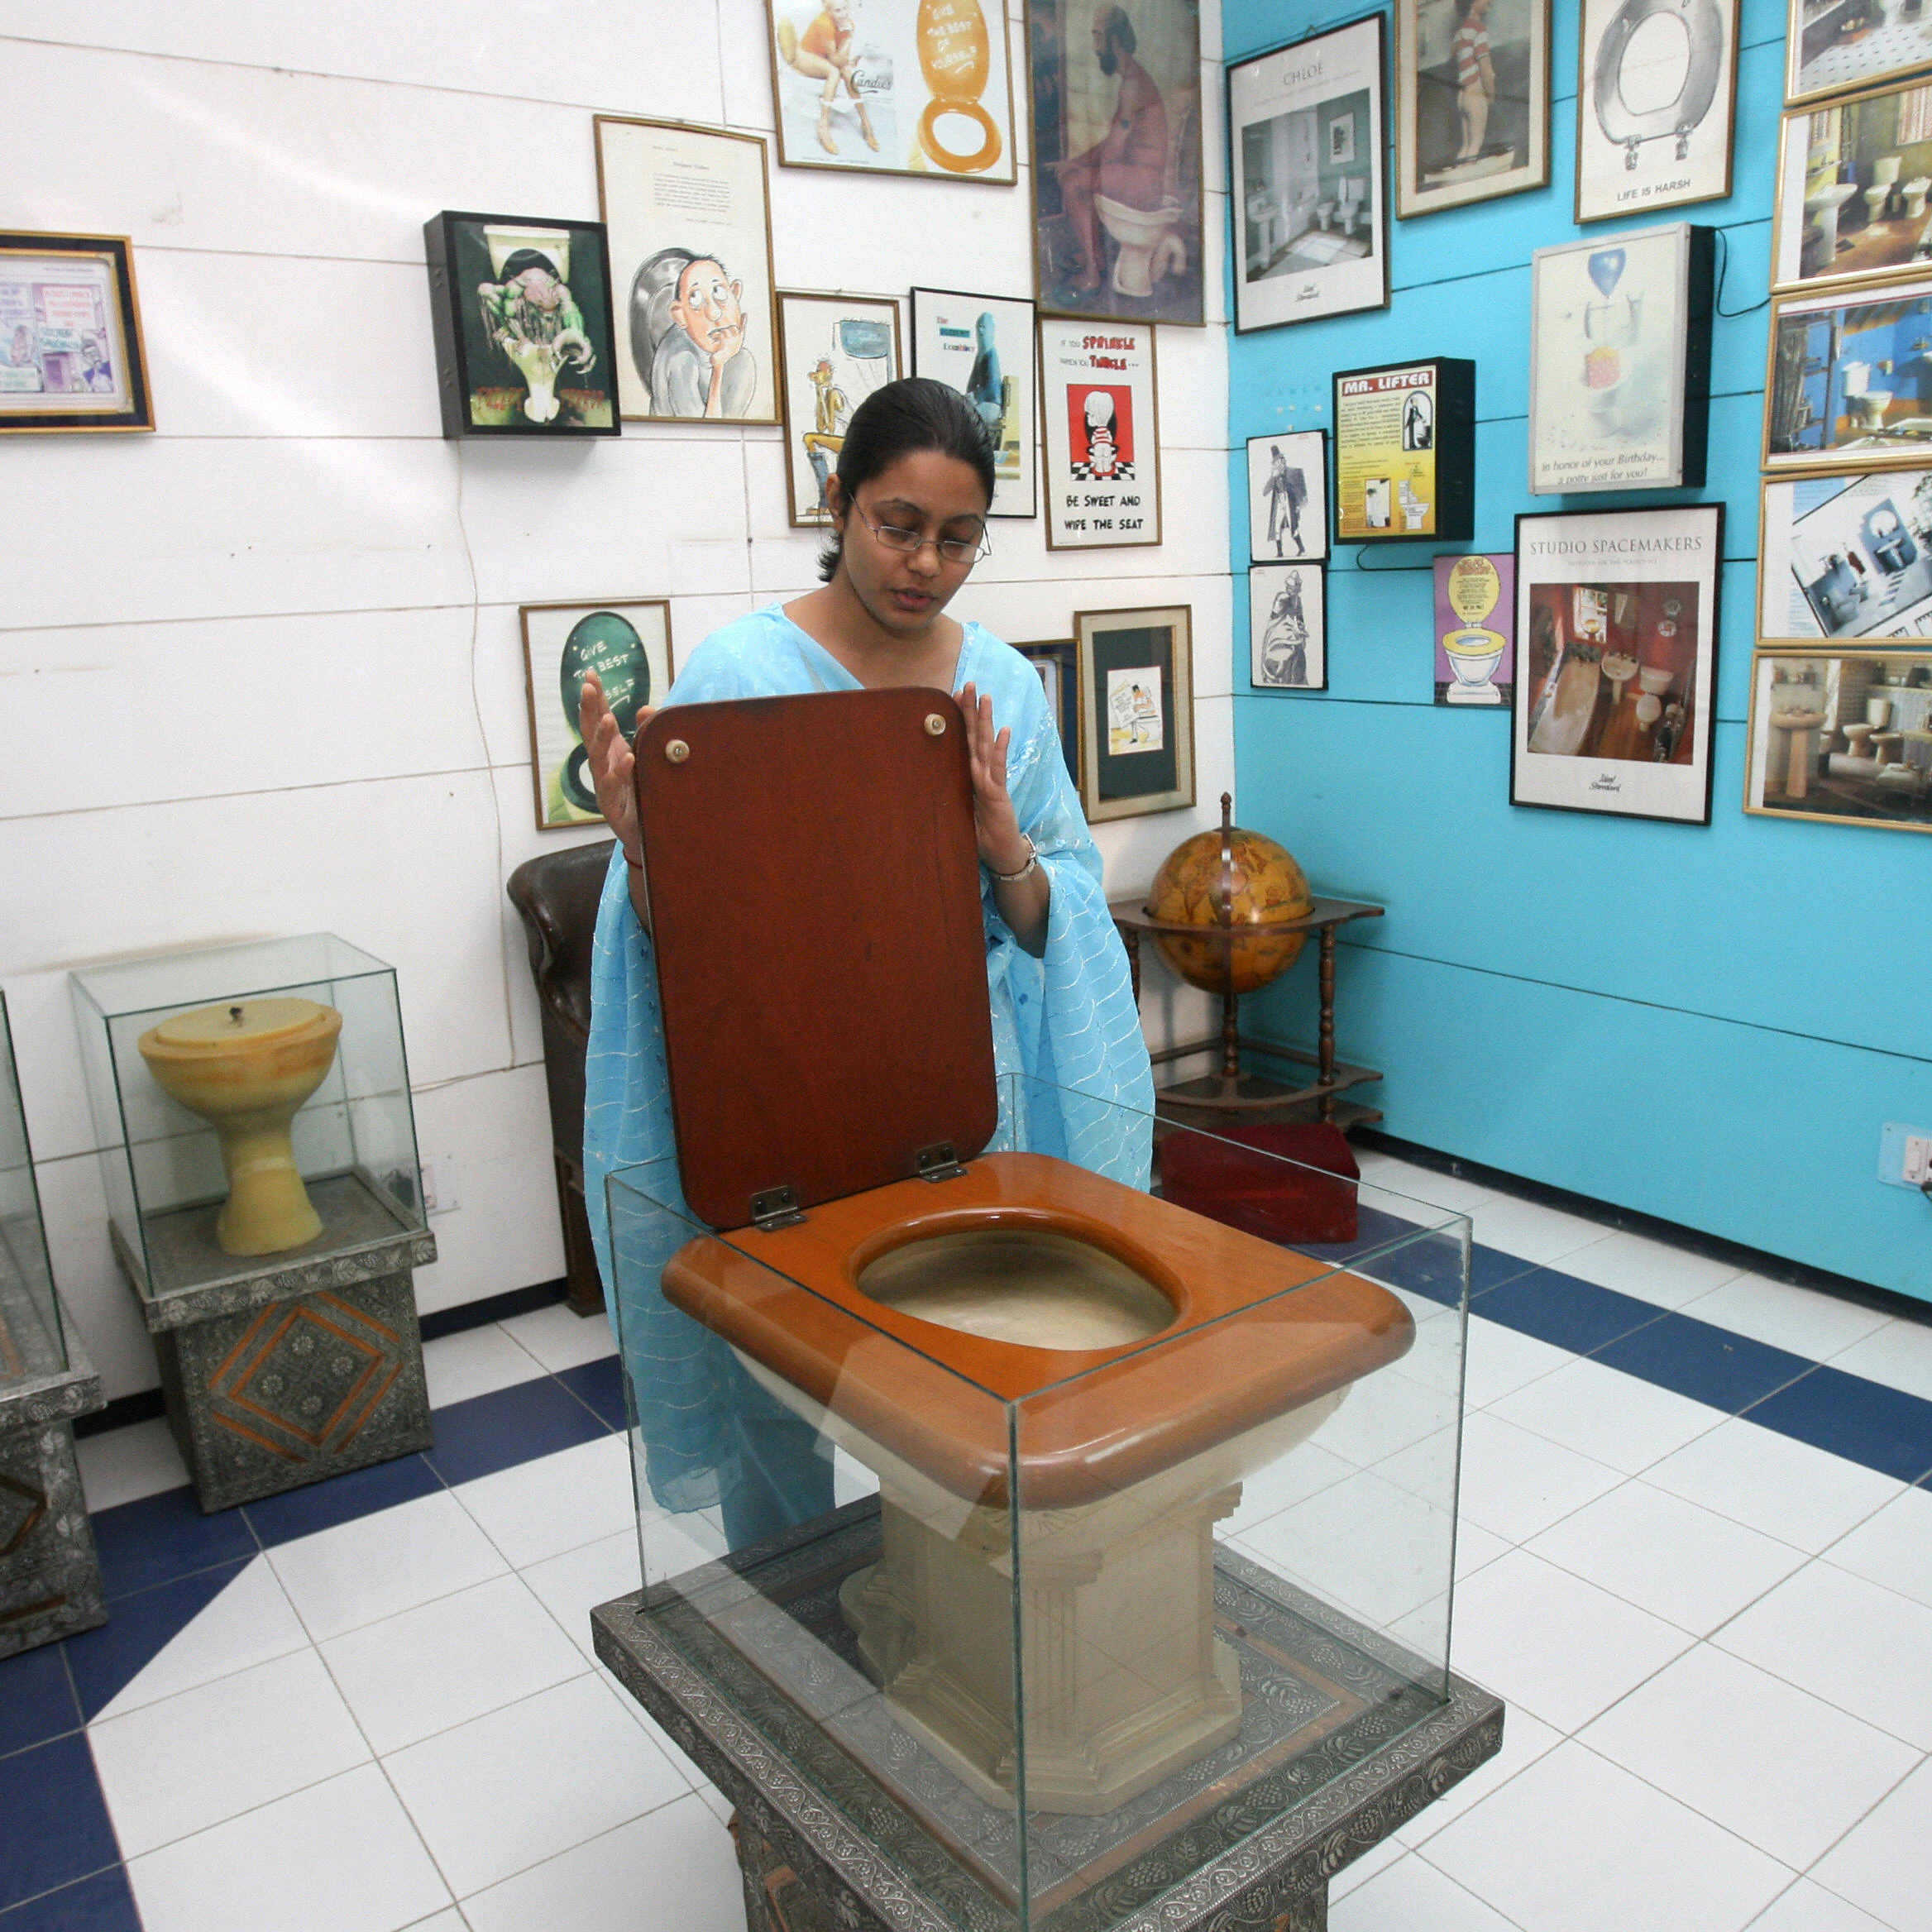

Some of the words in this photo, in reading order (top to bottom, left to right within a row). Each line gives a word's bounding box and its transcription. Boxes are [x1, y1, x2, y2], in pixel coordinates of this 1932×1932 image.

[1617, 189, 1638, 201] LIFE
[1641, 187, 1651, 196] IS
[1655, 179, 1690, 194] HARSH
[1344, 380, 1373, 395] MR.
[1378, 372, 1430, 390] LIFTER
[1553, 460, 1579, 471] honor
[1581, 458, 1591, 468] of
[1594, 458, 1614, 468] your
[1066, 495, 1079, 507] BE
[1084, 495, 1116, 507] SWEET
[1120, 495, 1141, 506] AND
[1064, 519, 1086, 530] WIPE
[1093, 519, 1112, 530] THE
[1119, 519, 1144, 530] SEAT
[1530, 540, 1586, 555] STUDIO
[1593, 536, 1702, 553] SPACEMAKERS
[581, 640, 607, 661] GIVE
[573, 666, 593, 678] TH
[597, 653, 629, 672] BEST
